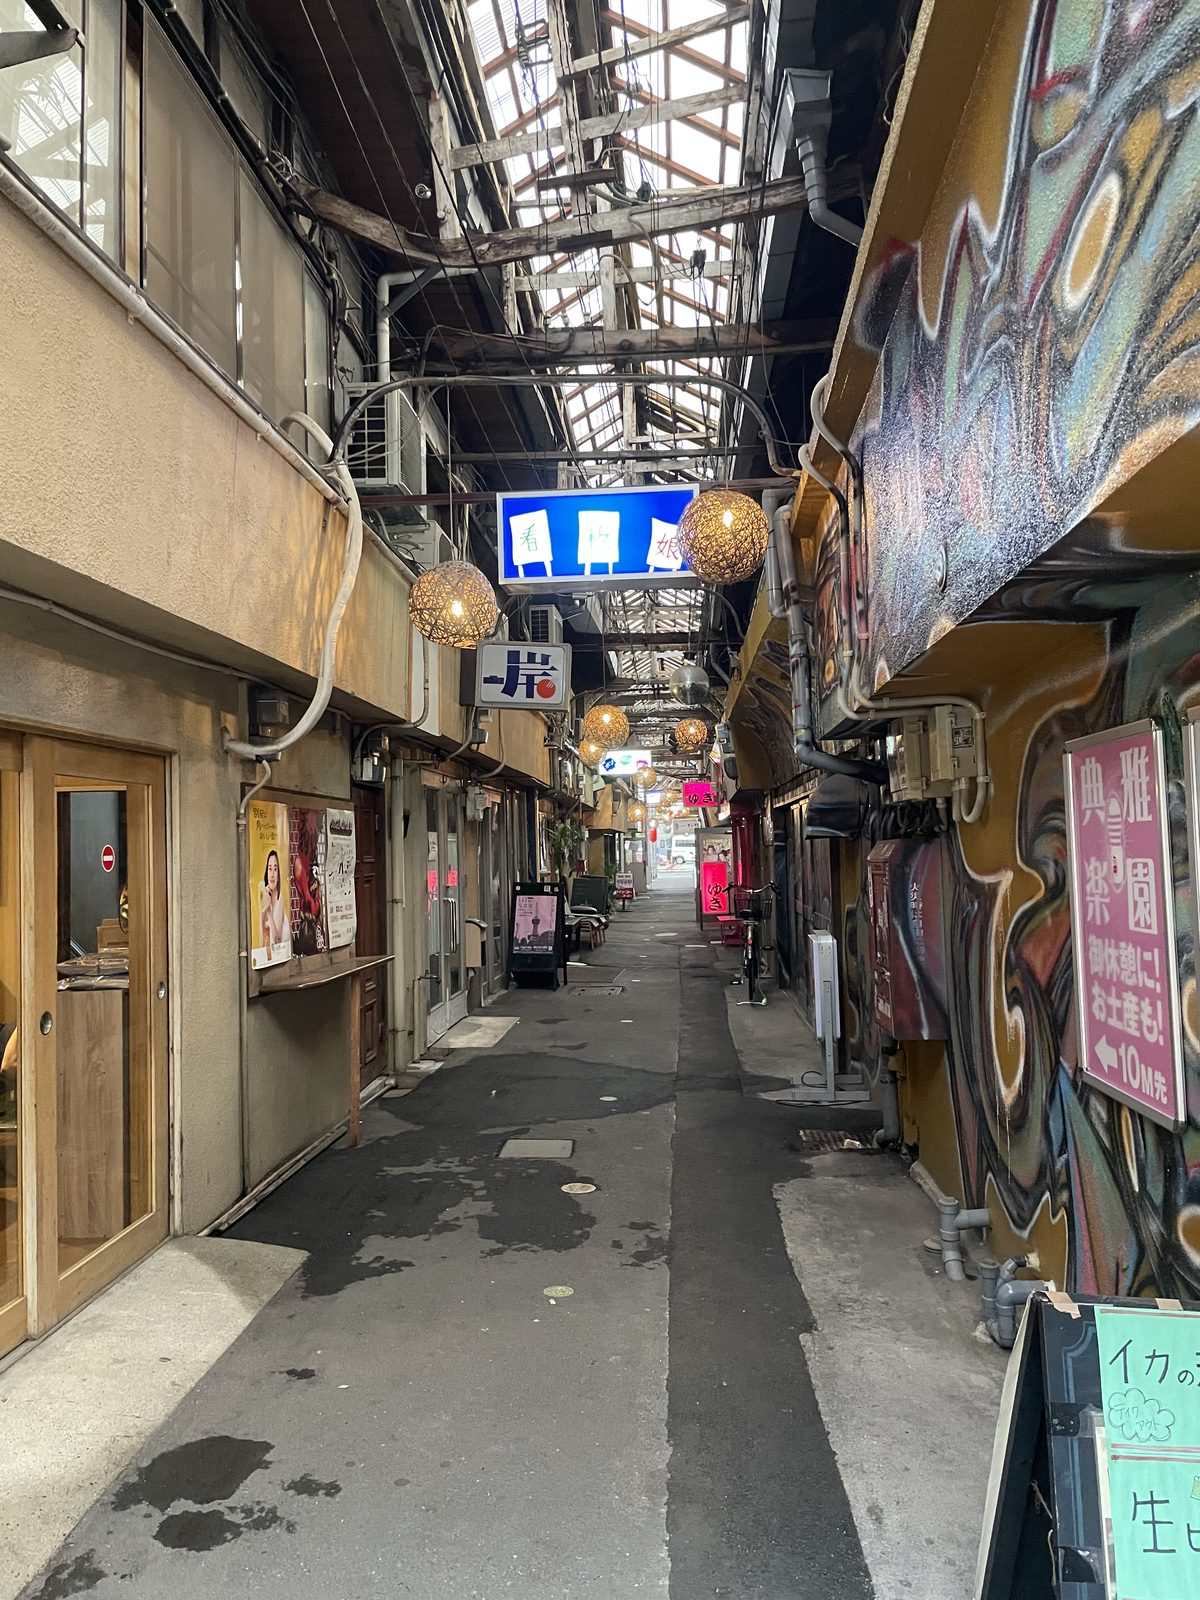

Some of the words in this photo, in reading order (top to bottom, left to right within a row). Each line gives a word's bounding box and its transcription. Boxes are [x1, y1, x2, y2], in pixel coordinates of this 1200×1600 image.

[707, 883, 722, 911] ゆき
[1109, 1339, 1200, 1386] イカの
